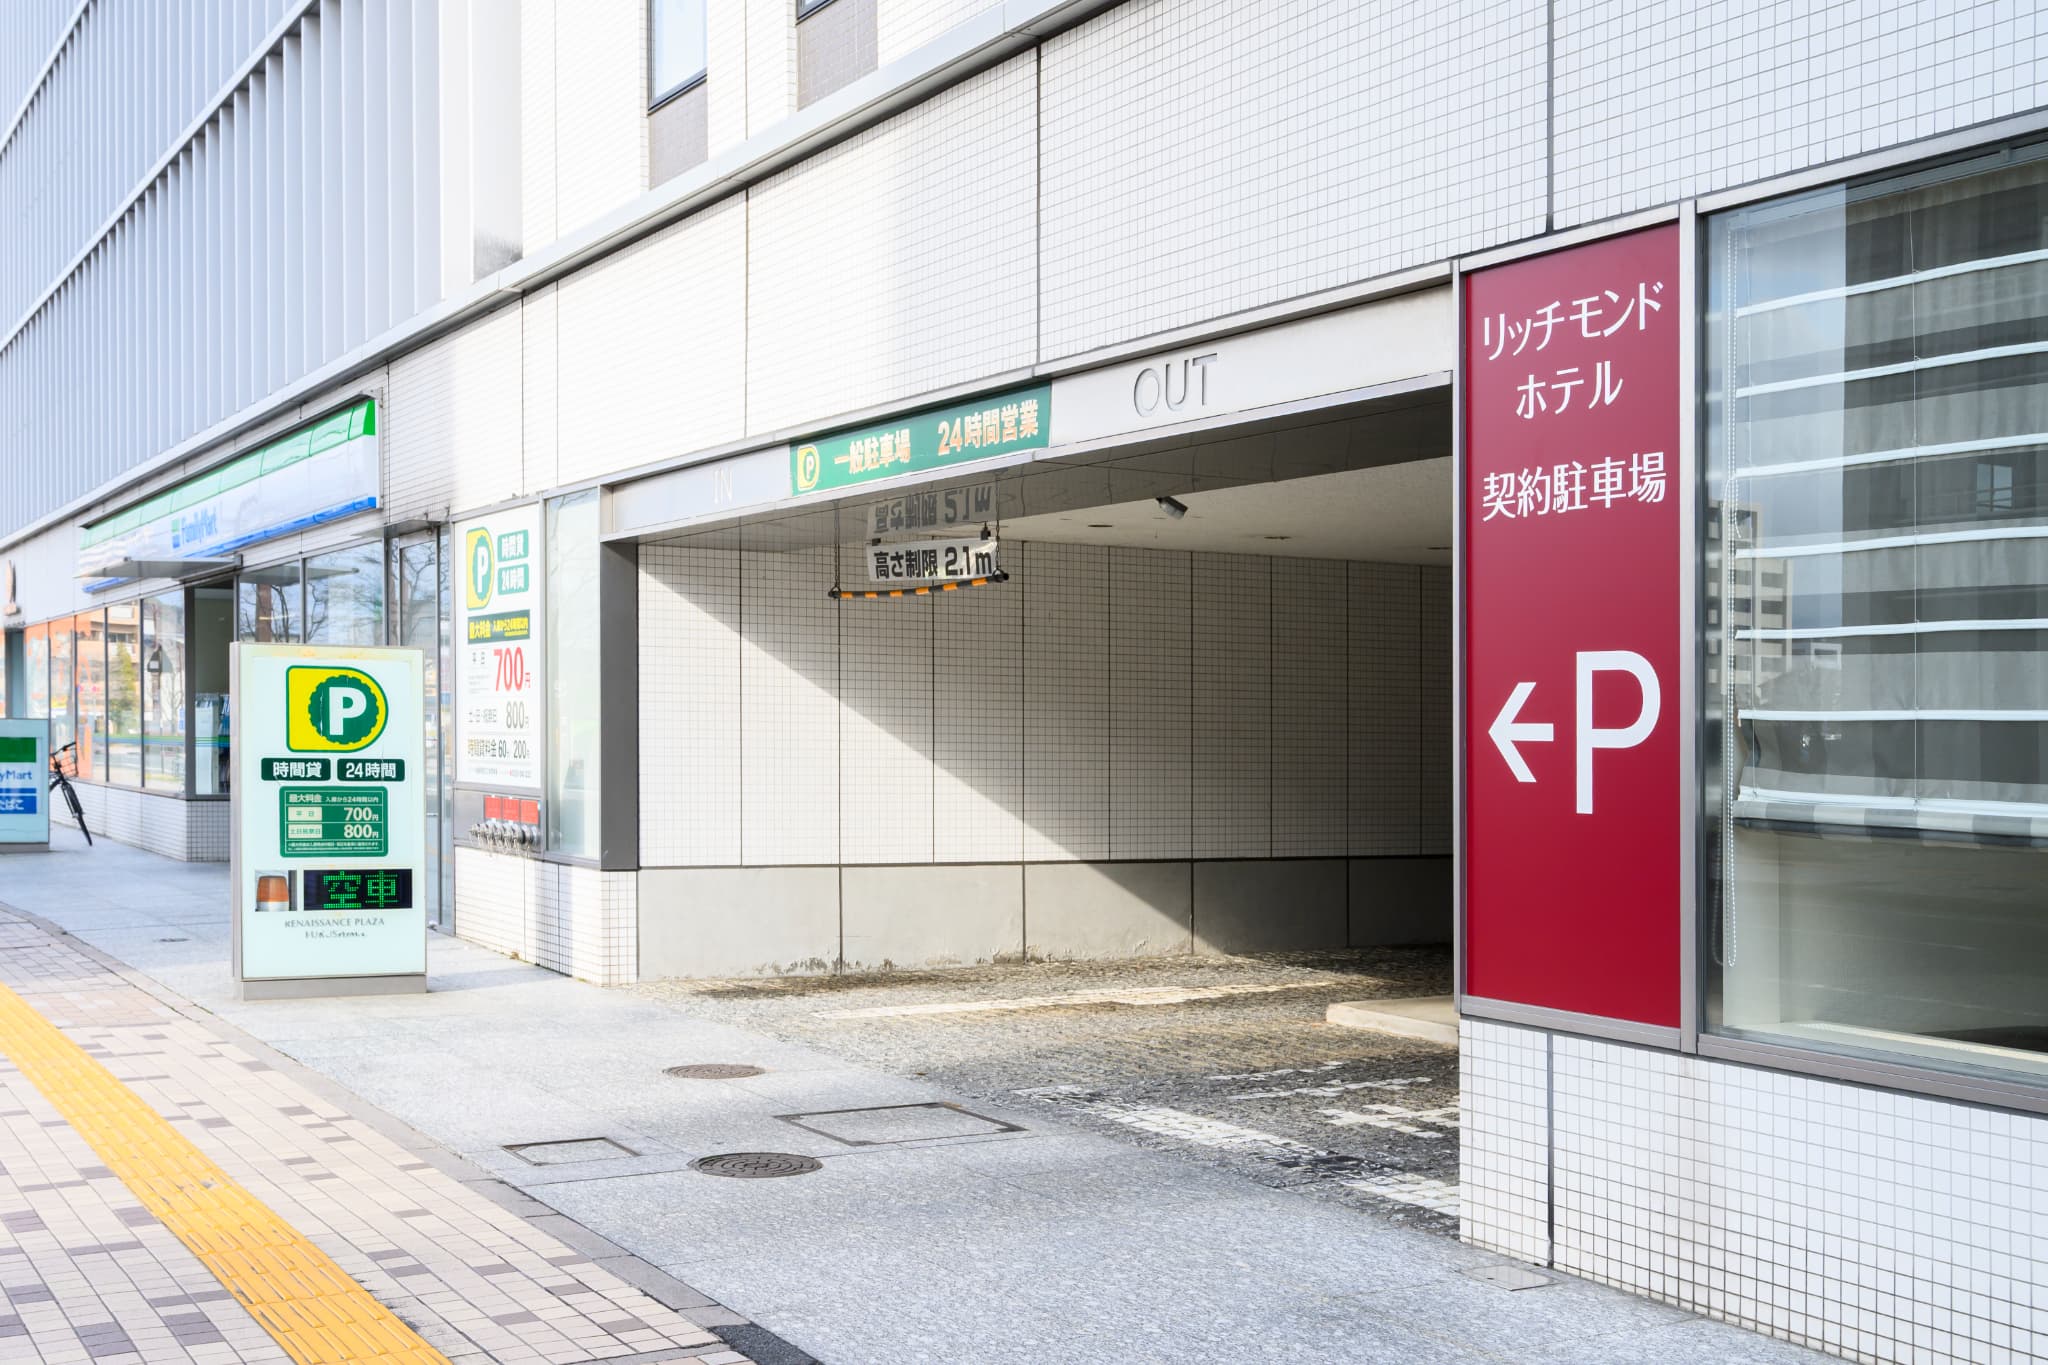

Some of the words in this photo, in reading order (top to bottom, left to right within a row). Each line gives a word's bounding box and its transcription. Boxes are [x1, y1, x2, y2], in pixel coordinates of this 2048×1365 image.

[1483, 281, 1664, 361] リッチモンド
[1133, 352, 1218, 417] OUT
[1516, 360, 1623, 419] ホテル
[834, 429, 911, 475] 一般駐車場
[938, 399, 1039, 456] 24時間営業
[713, 468, 734, 504] IN
[1482, 452, 1666, 522] 契約駐車場
[477, 546, 489, 593] P
[874, 549, 938, 579] 高さ制限
[944, 546, 992, 576] 2.1m
[328, 686, 367, 736] P
[1576, 650, 1661, 814] P
[272, 762, 322, 778] 時間貸
[345, 762, 397, 778] 24時間
[289, 793, 322, 803] 最大料金
[343, 807, 379, 821] 700円
[343, 824, 379, 838] 800円
[323, 870, 400, 909] 空車
[284, 919, 351, 928] RENAISSANCE
[355, 918, 385, 926] PLAZA
